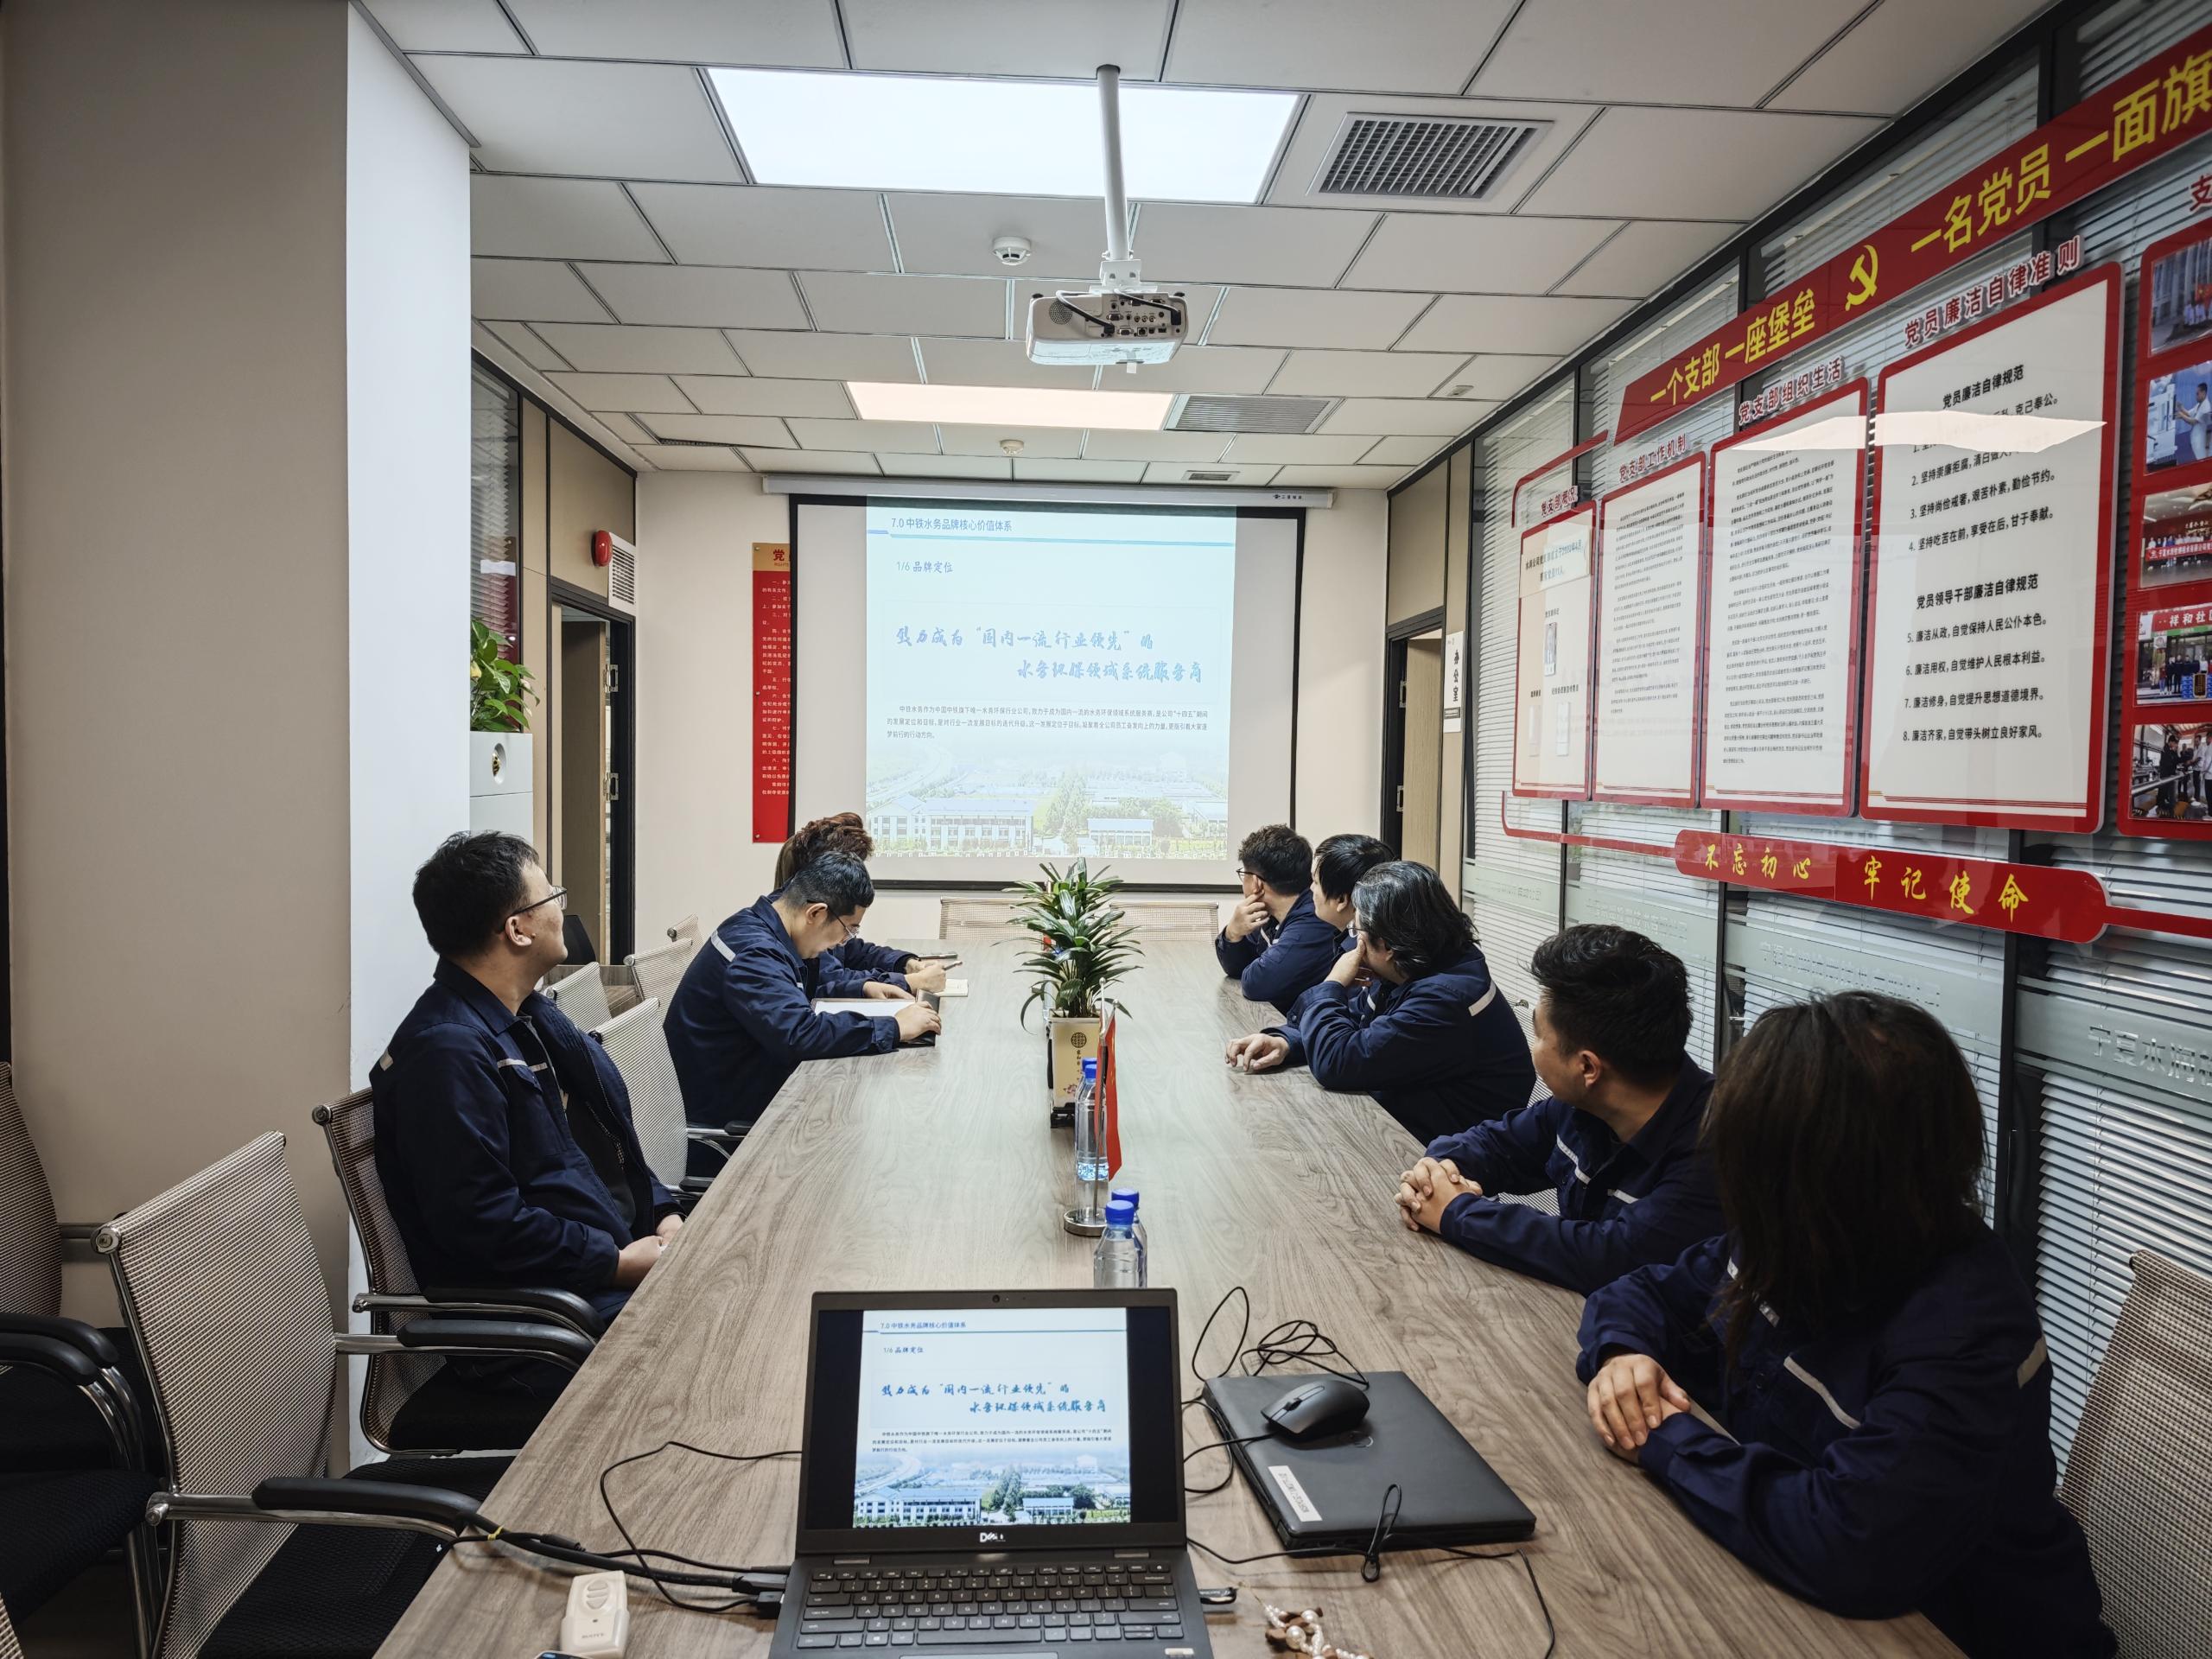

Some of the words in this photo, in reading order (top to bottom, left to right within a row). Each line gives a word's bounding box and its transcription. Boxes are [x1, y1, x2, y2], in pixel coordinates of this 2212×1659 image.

[1904, 235, 2081, 348] 党员廉洁自律准则
[1738, 356, 1843, 425] 党支部组织生活
[1942, 365, 2024, 409] 党员廉洁自律规范
[1619, 434, 1686, 483] 党支部工作机制
[906, 518, 1012, 531] 中铁水务品牌核心价值体系
[912, 562, 953, 573] 品牌定位
[1916, 574, 2038, 610] 党员领导干部廉洁自律规范
[1705, 842, 1811, 880] 不忘初心
[1864, 855, 2029, 923] 牢记使命
